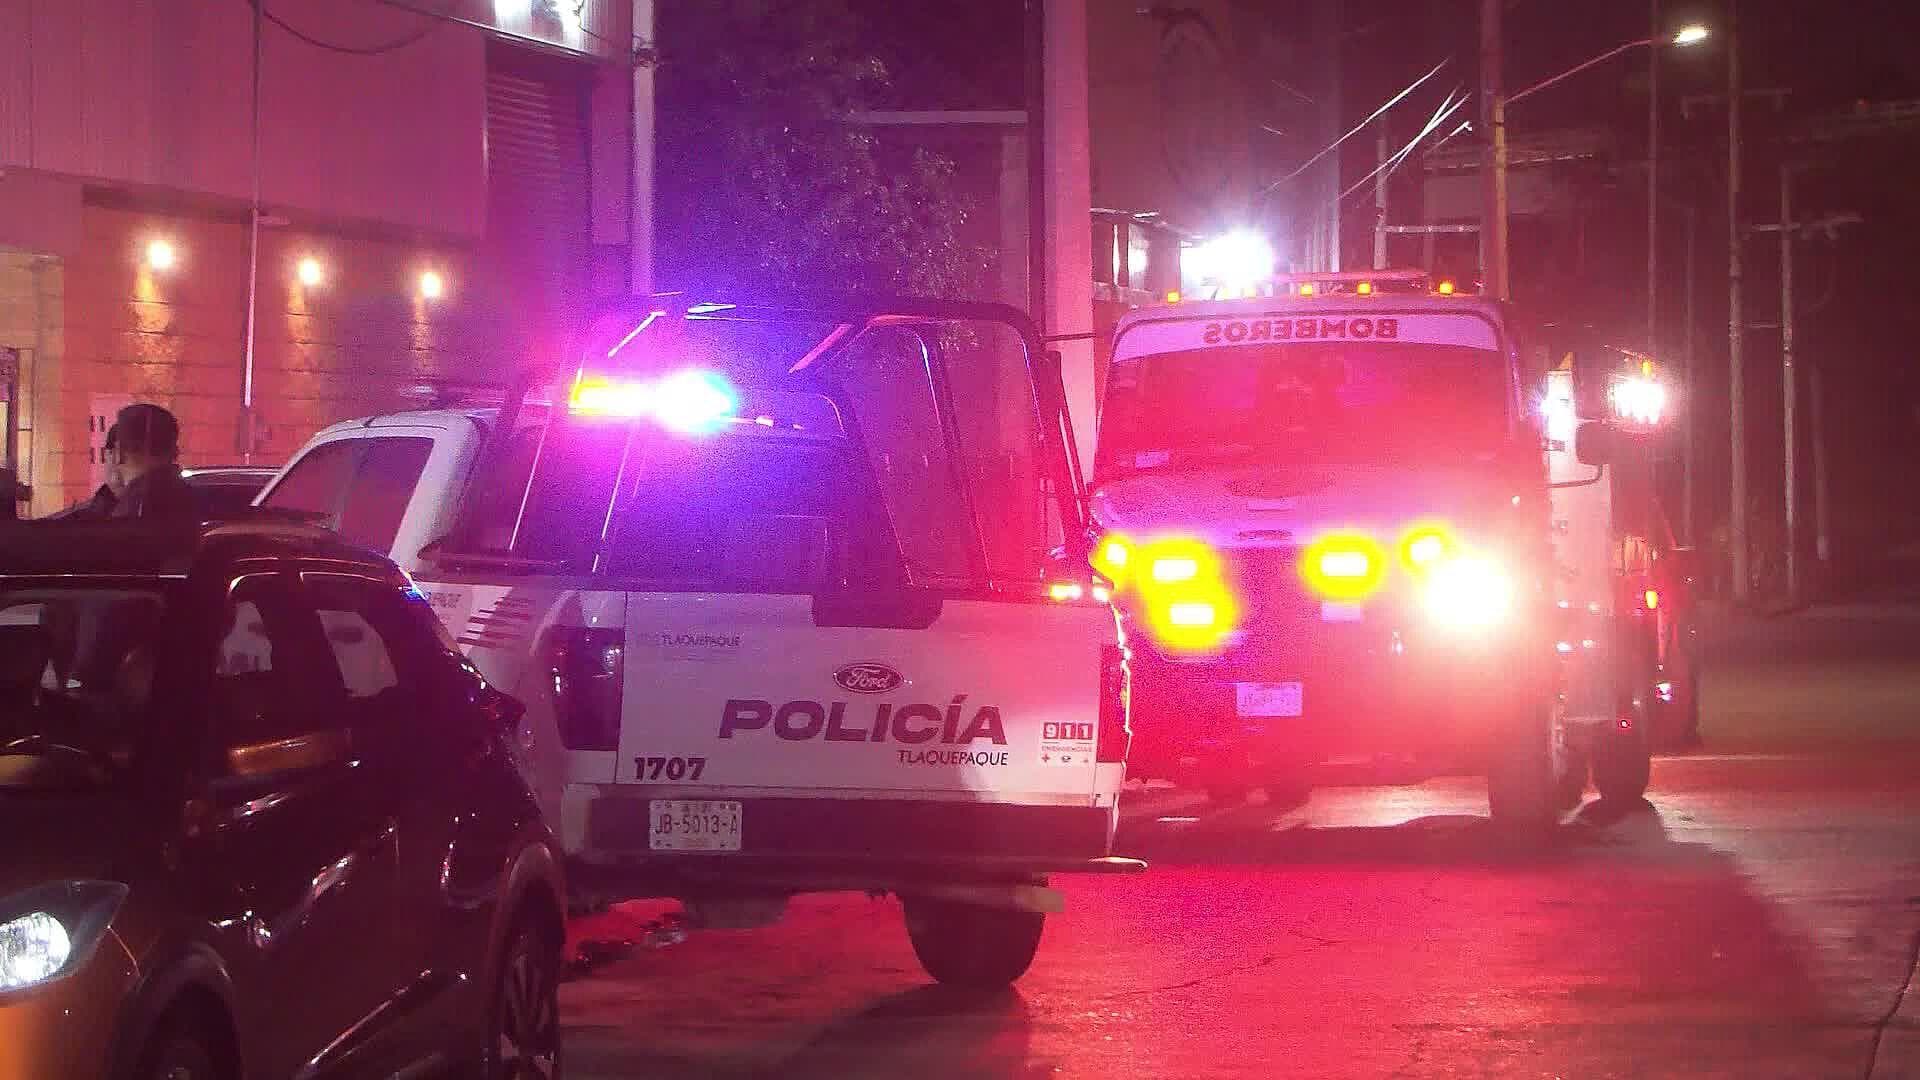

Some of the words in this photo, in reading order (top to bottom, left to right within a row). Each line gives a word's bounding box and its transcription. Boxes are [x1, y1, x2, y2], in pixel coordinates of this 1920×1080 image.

[846, 668, 890, 688] Ford
[718, 694, 1008, 745] POLICÍA
[1044, 722, 1093, 740] 911
[634, 757, 705, 780] 1707
[898, 750, 1009, 767] TLAQUEPAQUE
